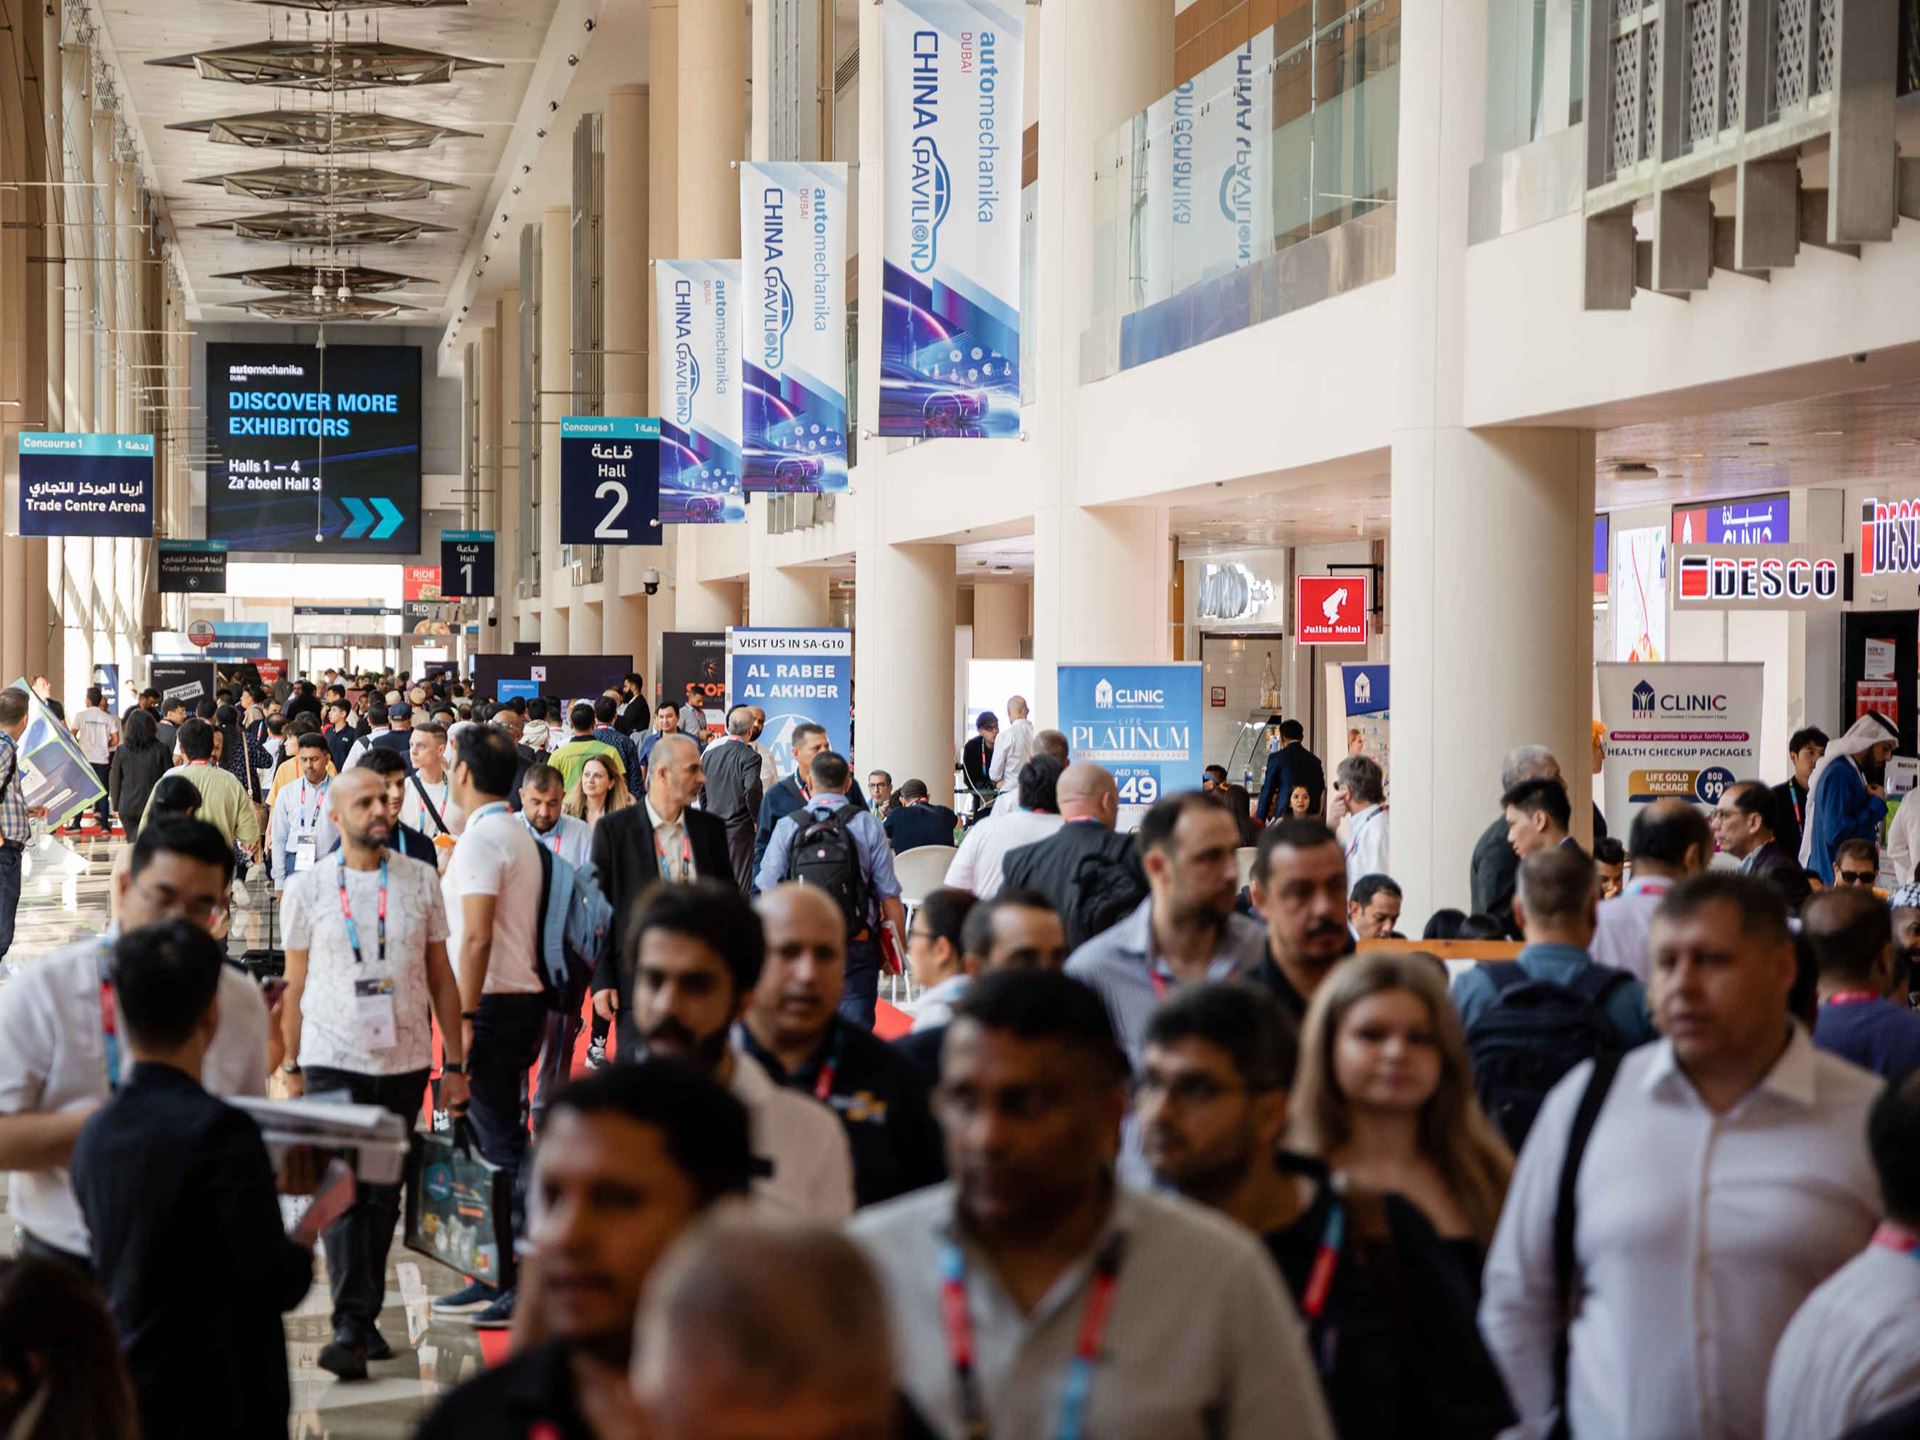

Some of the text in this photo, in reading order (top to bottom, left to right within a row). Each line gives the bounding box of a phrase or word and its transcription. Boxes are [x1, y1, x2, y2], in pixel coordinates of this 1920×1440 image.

[961, 32, 972, 73] DUBAI
[978, 31, 1000, 223] automechanika
[911, 31, 938, 259] CHINA PAVILION
[800, 189, 808, 219] DUBAI
[814, 188, 830, 331] automechanika
[764, 188, 783, 358] CHINA PAVILION
[716, 280, 729, 395] automechanika
[676, 280, 691, 416] CHINA PAVILION
[230, 365, 303, 375] automechanika
[229, 392, 397, 412] DISCOVER MORE
[229, 417, 350, 436] EXHIBITORS
[563, 422, 614, 432] Concourse 1
[24, 438, 82, 449] Concourse 1
[125, 440, 149, 451] ردهة
[591, 443, 633, 459] قاعة
[229, 459, 261, 473] Halls
[263, 460, 270, 473] 1
[291, 460, 300, 473] 4
[598, 464, 626, 477] Hall
[29, 480, 143, 498] أرينا المركز التجاري
[228, 476, 322, 491] Za'abeel Hall 3
[26, 499, 146, 513] Trade Centre Arena
[594, 481, 628, 538] 2
[204, 565, 224, 573] Arena
[460, 563, 472, 594] 1
[1712, 558, 1837, 599] DESCO
[412, 604, 429, 612] RID
[1304, 624, 1360, 634] Julius Meinl
[740, 639, 844, 649] VISIT US IN SA-G10
[747, 664, 836, 678] AL RABEE
[744, 684, 838, 698] AL AKHDER
[1115, 690, 1164, 703] CLINIC
[1660, 694, 1727, 712] CLINIC
[1119, 718, 1141, 726] LIFE
[1072, 726, 1189, 749] PLATINUM
[1653, 733, 1679, 741] promise
[1704, 733, 1724, 741] family
[1725, 733, 1745, 741] today!
[1607, 748, 1752, 757] HEALTH CHECKUP PACKAGES
[1115, 768, 1131, 776] AED
[1646, 773, 1688, 781] LIFE GOLD
[1707, 773, 1723, 781] 800
[1115, 777, 1157, 804] 49
[1649, 783, 1688, 792] PACKAGE
[1705, 783, 1724, 799] 99
